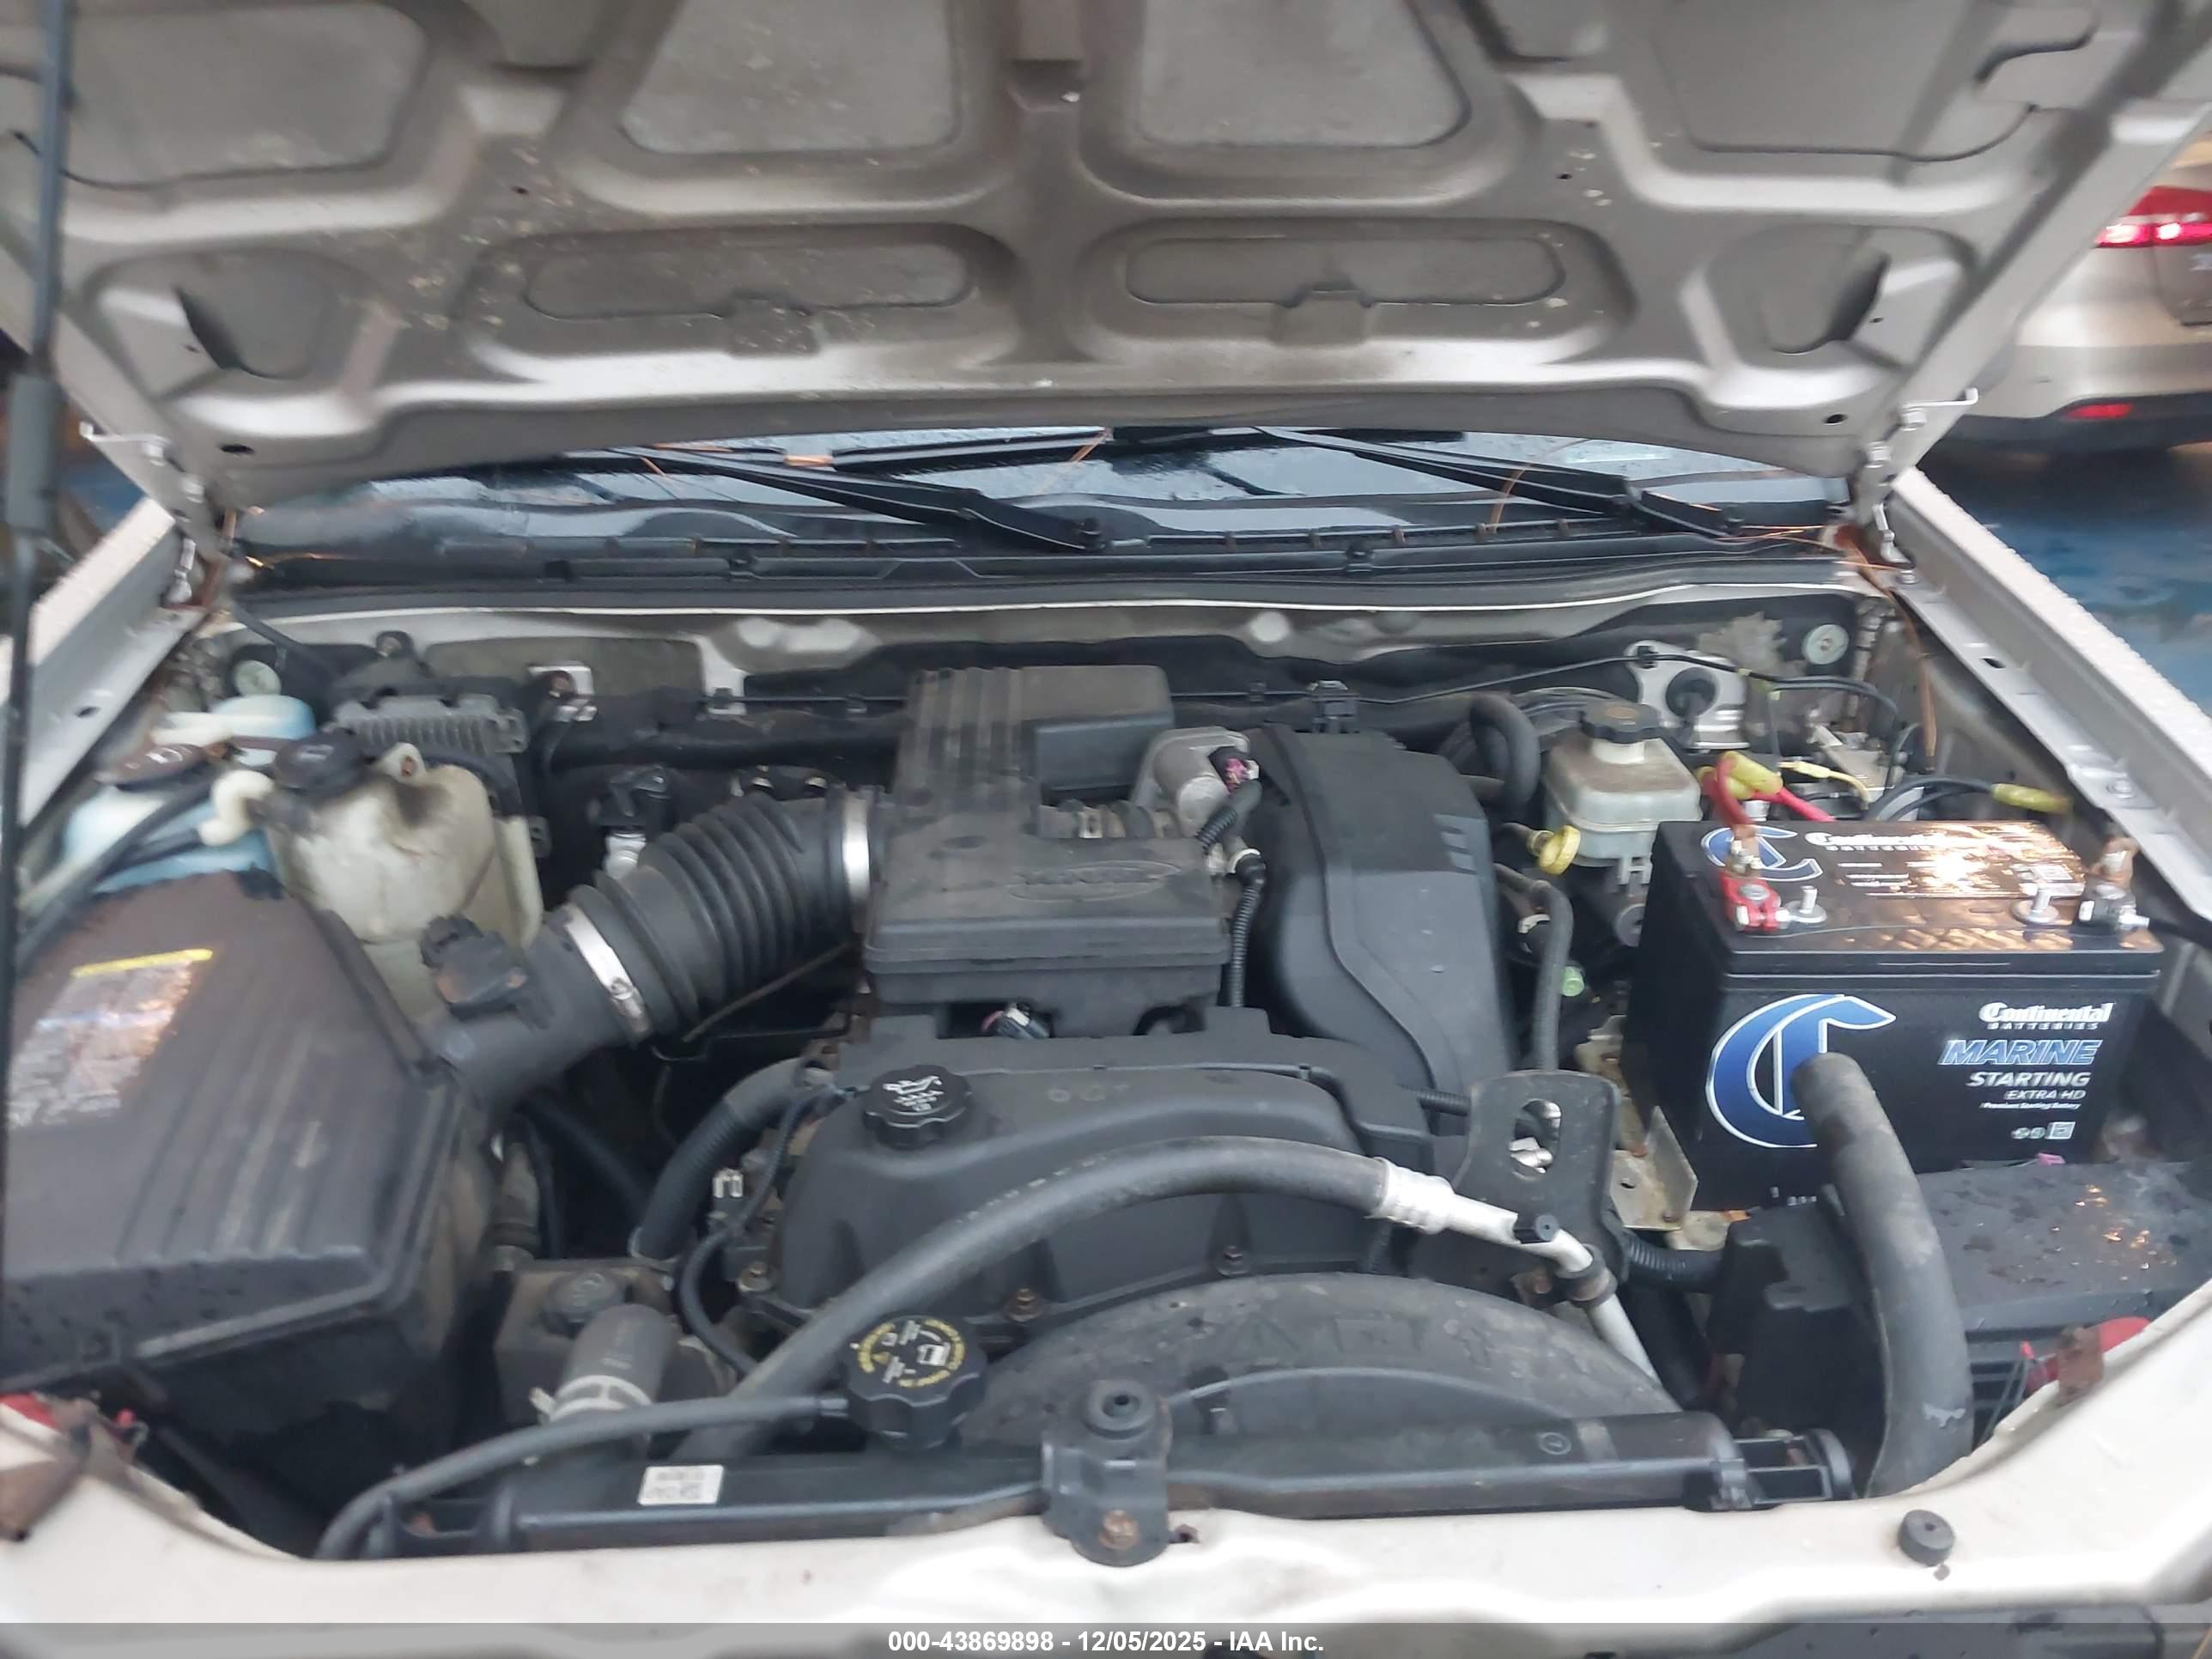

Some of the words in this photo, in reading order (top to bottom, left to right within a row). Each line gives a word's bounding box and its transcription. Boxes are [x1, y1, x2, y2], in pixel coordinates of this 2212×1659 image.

[1978, 1002, 2115, 1023] Continental
[1987, 1022, 2100, 1030] BATTERIES
[1937, 1039, 2103, 1065] MARINE
[1966, 1072, 2092, 1086] STARTING
[2003, 1090, 2057, 1100] EXTRA
[2061, 1090, 2087, 1100] HD
